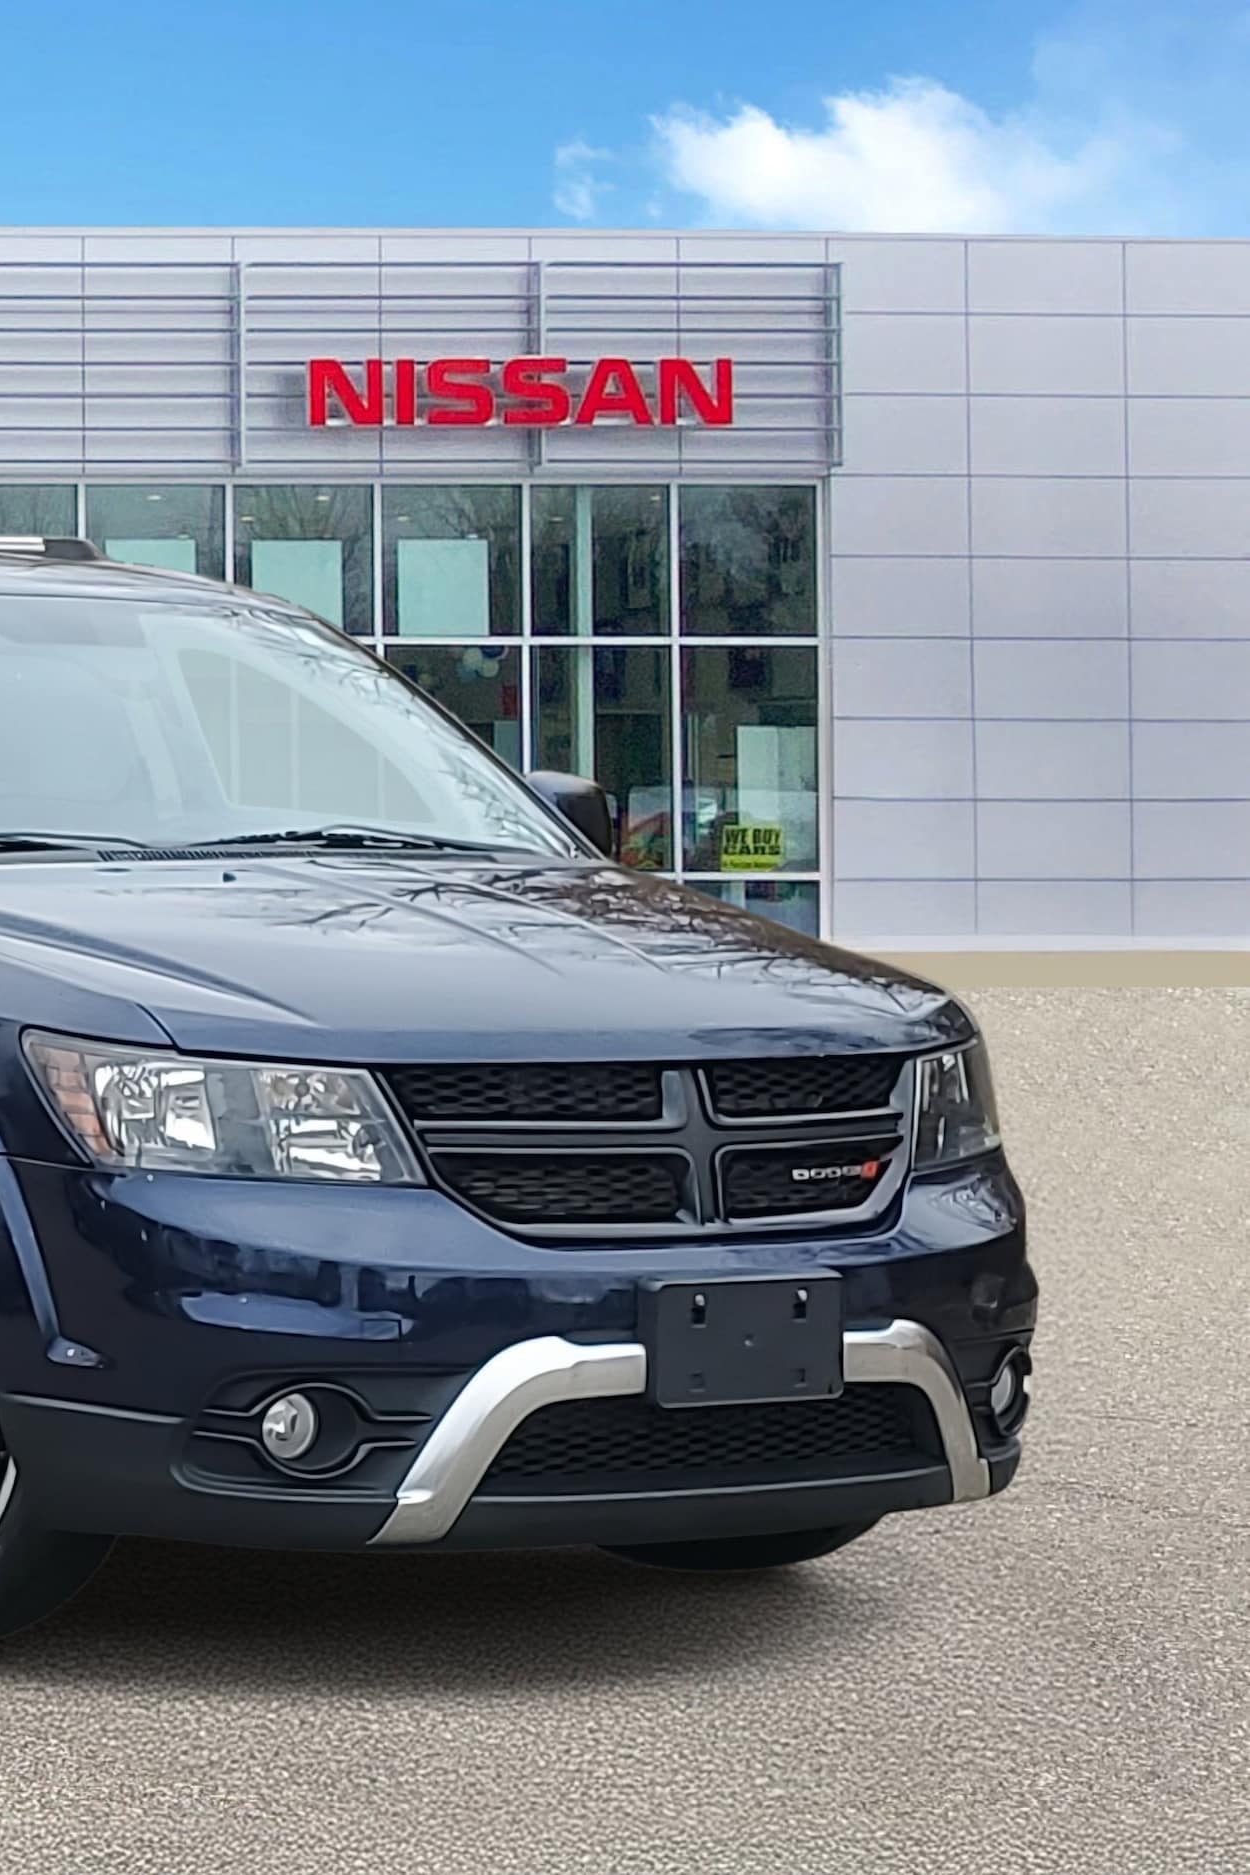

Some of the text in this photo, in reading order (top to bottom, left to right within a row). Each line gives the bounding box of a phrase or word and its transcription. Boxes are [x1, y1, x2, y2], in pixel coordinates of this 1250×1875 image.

[308, 358, 734, 426] NISSAN
[725, 828, 781, 844] WE BUY
[723, 845, 781, 855] CARS
